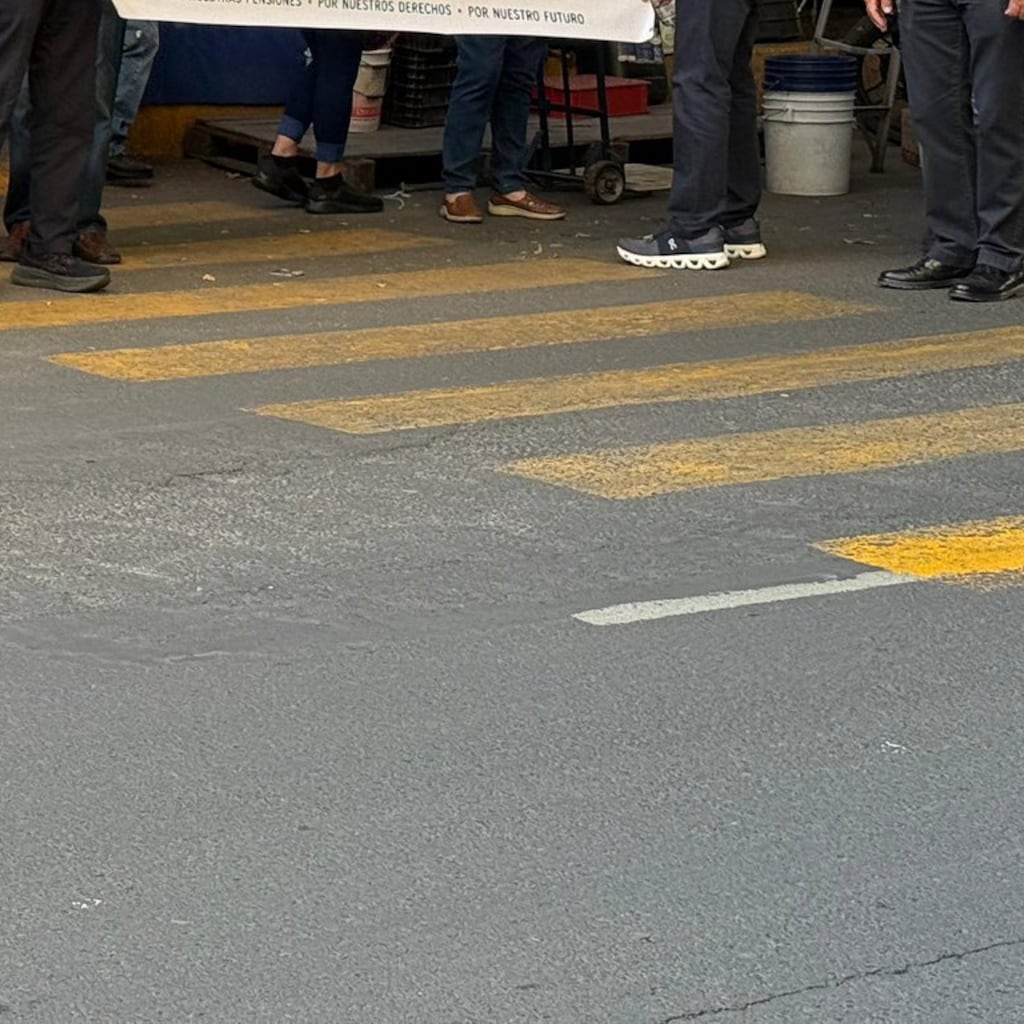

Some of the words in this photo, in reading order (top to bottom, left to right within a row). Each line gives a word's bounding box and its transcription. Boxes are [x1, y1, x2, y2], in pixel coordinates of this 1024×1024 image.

[398, 1, 452, 16] DERECHOS
[468, 5, 489, 19] POR
[493, 7, 541, 22] NUESTRO
[544, 10, 585, 25] FUTURO
